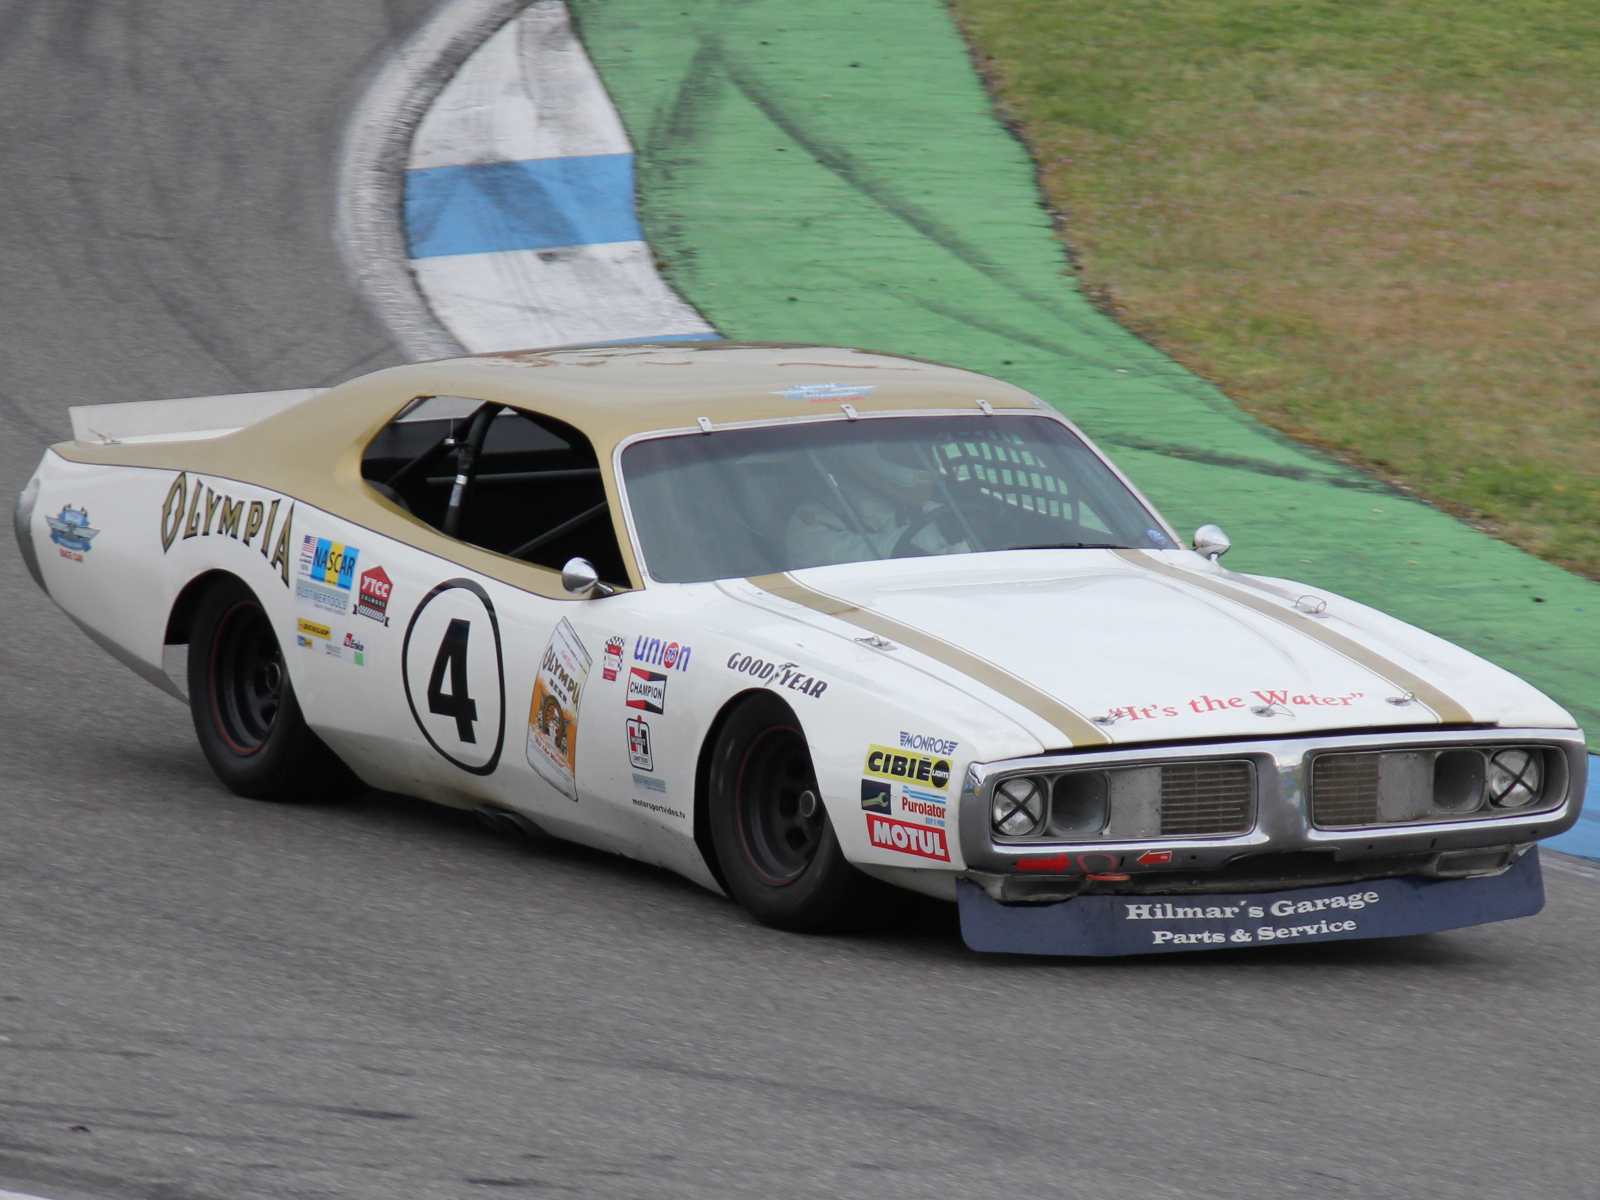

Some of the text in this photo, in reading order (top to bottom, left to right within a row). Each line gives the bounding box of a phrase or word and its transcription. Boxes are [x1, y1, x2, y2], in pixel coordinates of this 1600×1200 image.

[161, 471, 295, 589] OLYMPIA
[312, 546, 356, 578] NASCAR
[361, 575, 390, 598] YTCC
[303, 623, 330, 636] DUNLOP
[427, 618, 478, 744] 4
[542, 643, 581, 711] OLYMPIA
[549, 677, 568, 705] BEER
[630, 681, 663, 701] CHAMPION
[1188, 695, 1246, 713] the
[904, 732, 951, 755] MONROE
[868, 750, 932, 782] CIBIÉ
[932, 769, 950, 779] LIGHTS
[902, 796, 946, 819] Purolator
[874, 820, 945, 857] MOTUL
[1270, 891, 1380, 917] Garage
[1152, 919, 1357, 945] Parts & Service
